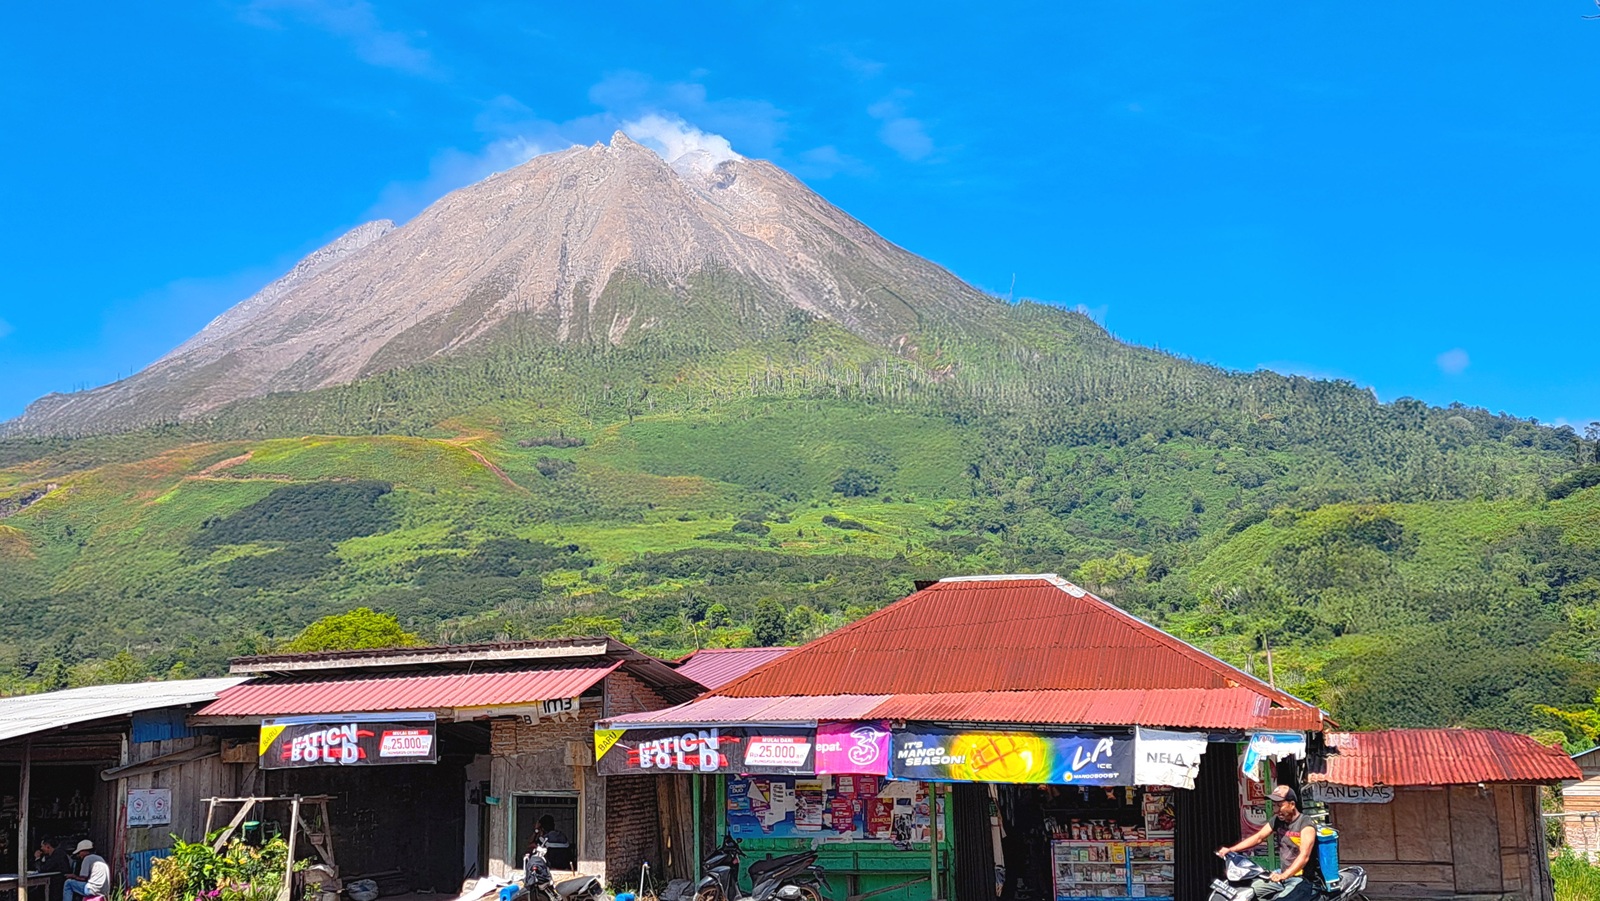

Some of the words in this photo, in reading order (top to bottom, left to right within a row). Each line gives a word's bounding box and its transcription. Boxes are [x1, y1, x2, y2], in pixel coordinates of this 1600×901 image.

[543, 698, 572, 714] IM3
[262, 728, 278, 748] BARU
[391, 737, 422, 750] 25.000
[598, 731, 617, 752] BARU
[291, 738, 359, 765] BOLD
[759, 745, 796, 758] 25.000
[904, 741, 923, 750] IT'S
[640, 744, 720, 772] BOLD
[897, 747, 945, 759] MANGO
[1146, 752, 1185, 765] NELA
[905, 755, 966, 767] SEASON!
